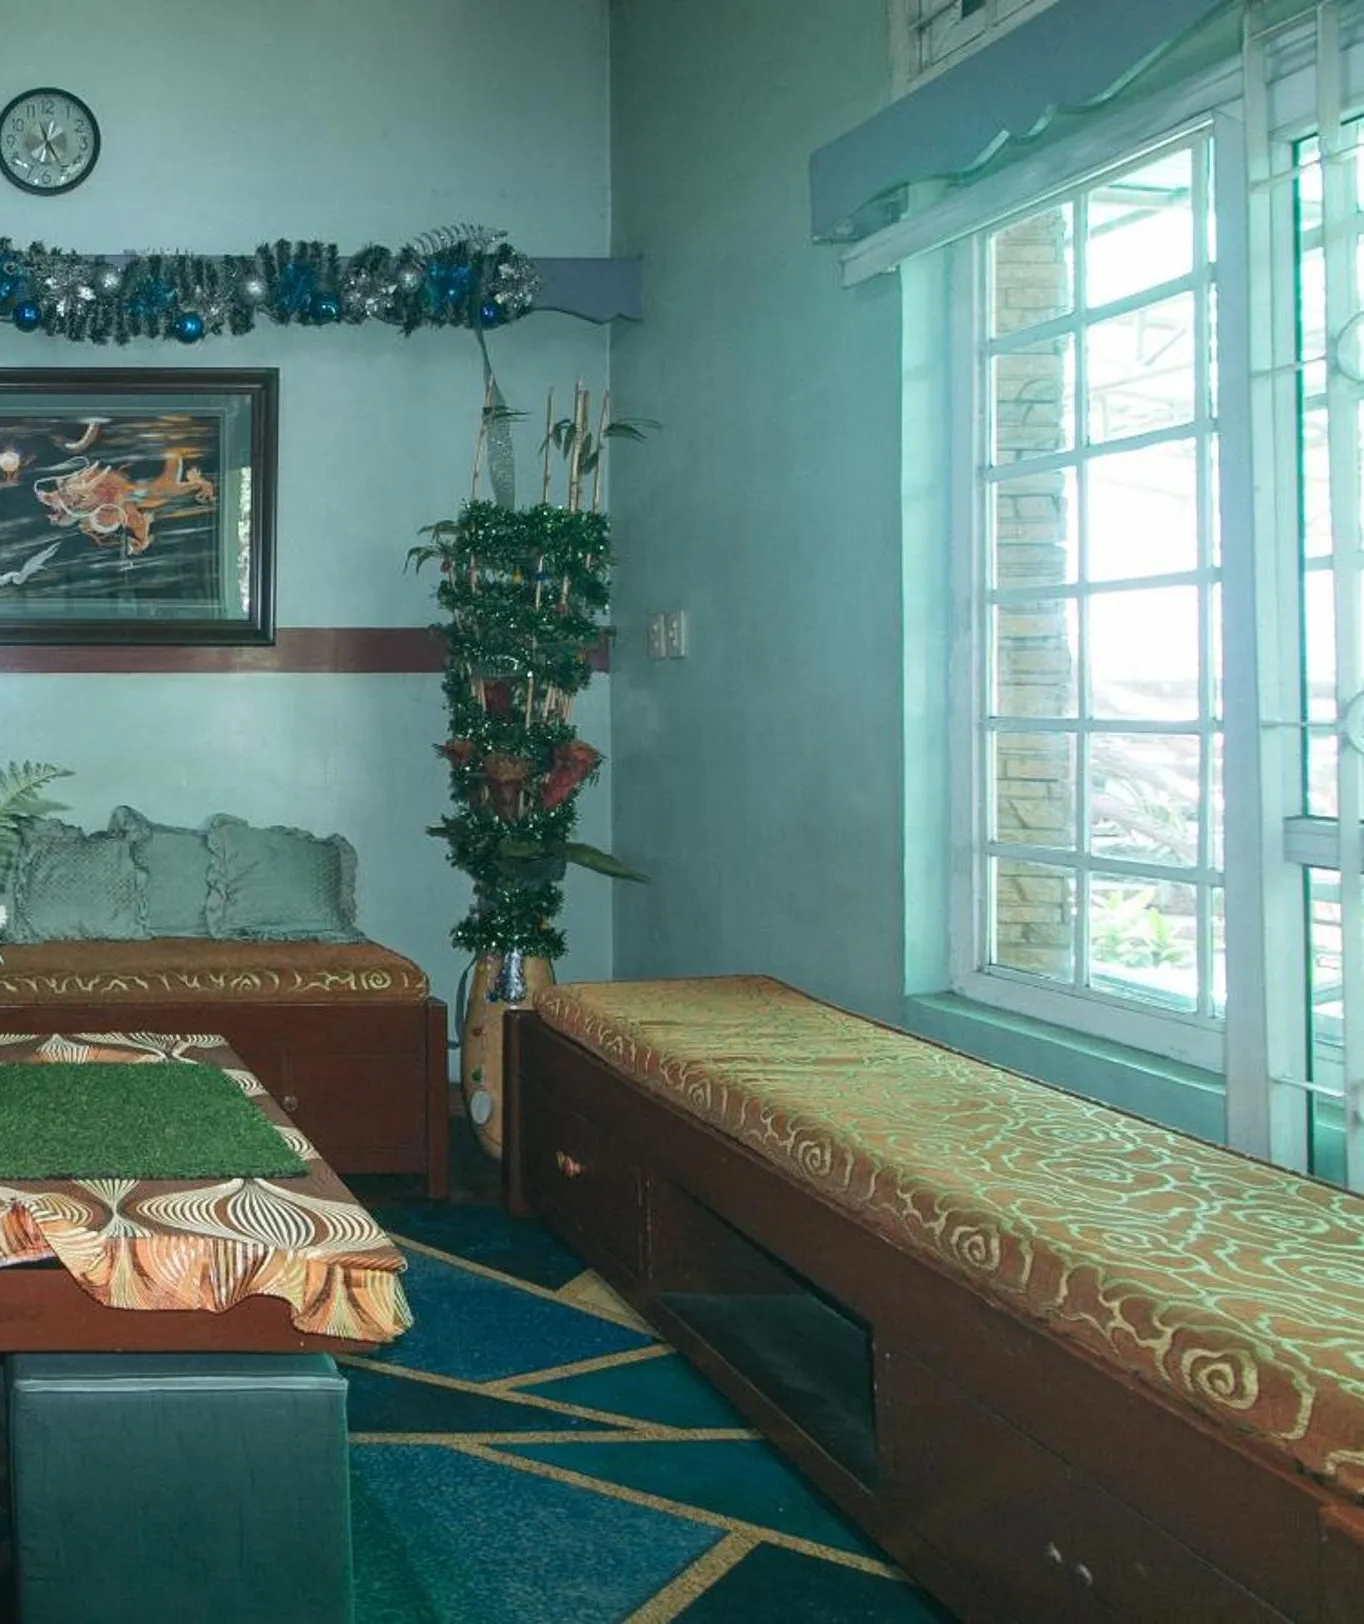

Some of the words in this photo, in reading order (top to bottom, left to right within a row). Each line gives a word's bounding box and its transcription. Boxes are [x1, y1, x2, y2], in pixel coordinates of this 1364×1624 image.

[26, 104, 35, 118] 11
[41, 100, 55, 115] 12
[12, 117, 24, 132] 10
[42, 169, 52, 185] 6
